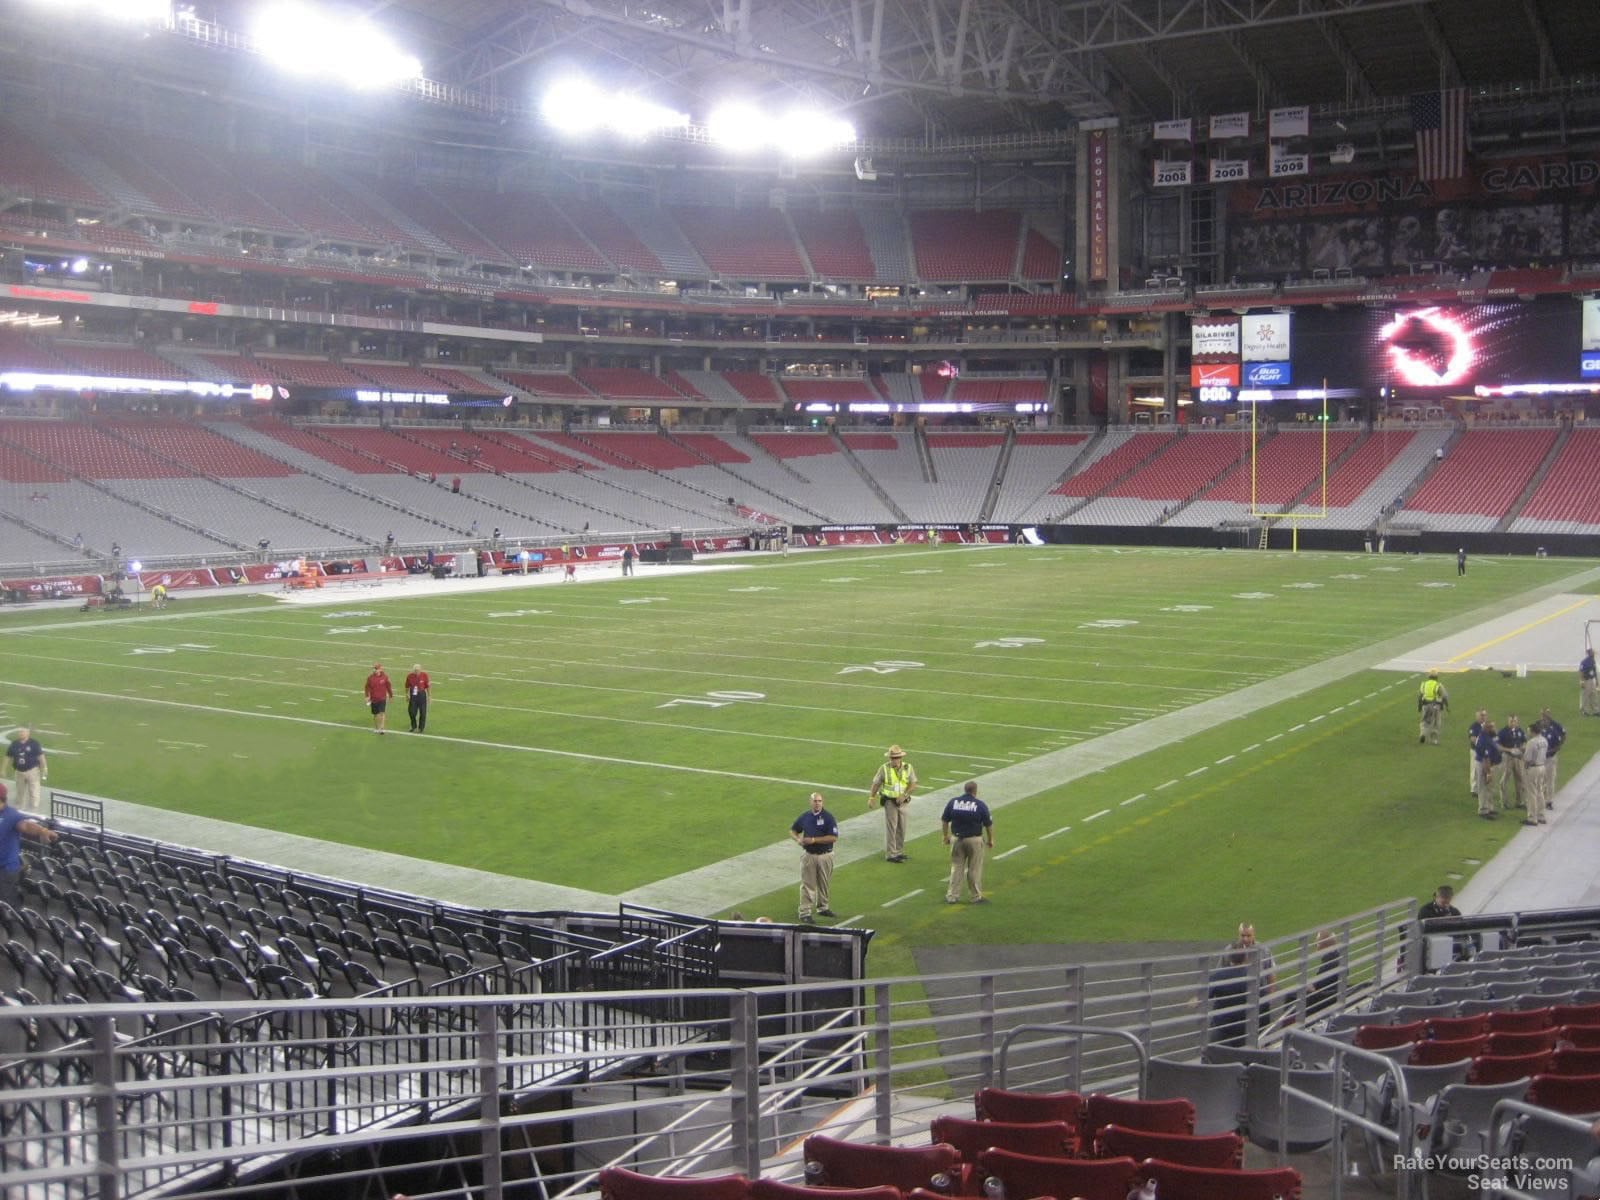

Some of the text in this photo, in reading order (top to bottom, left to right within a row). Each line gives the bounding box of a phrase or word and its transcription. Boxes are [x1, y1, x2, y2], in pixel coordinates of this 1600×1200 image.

[1215, 166, 1244, 178] 2008
[1274, 161, 1304, 173] 2009
[1157, 172, 1187, 183] 2008
[1256, 177, 1432, 210] ARIZONA
[1094, 147, 1103, 277] FOOTBALL CLUB
[1266, 342, 1287, 350] Health
[1258, 367, 1280, 375] BUD
[1200, 377, 1230, 386] verizon
[653, 690, 766, 709] 10
